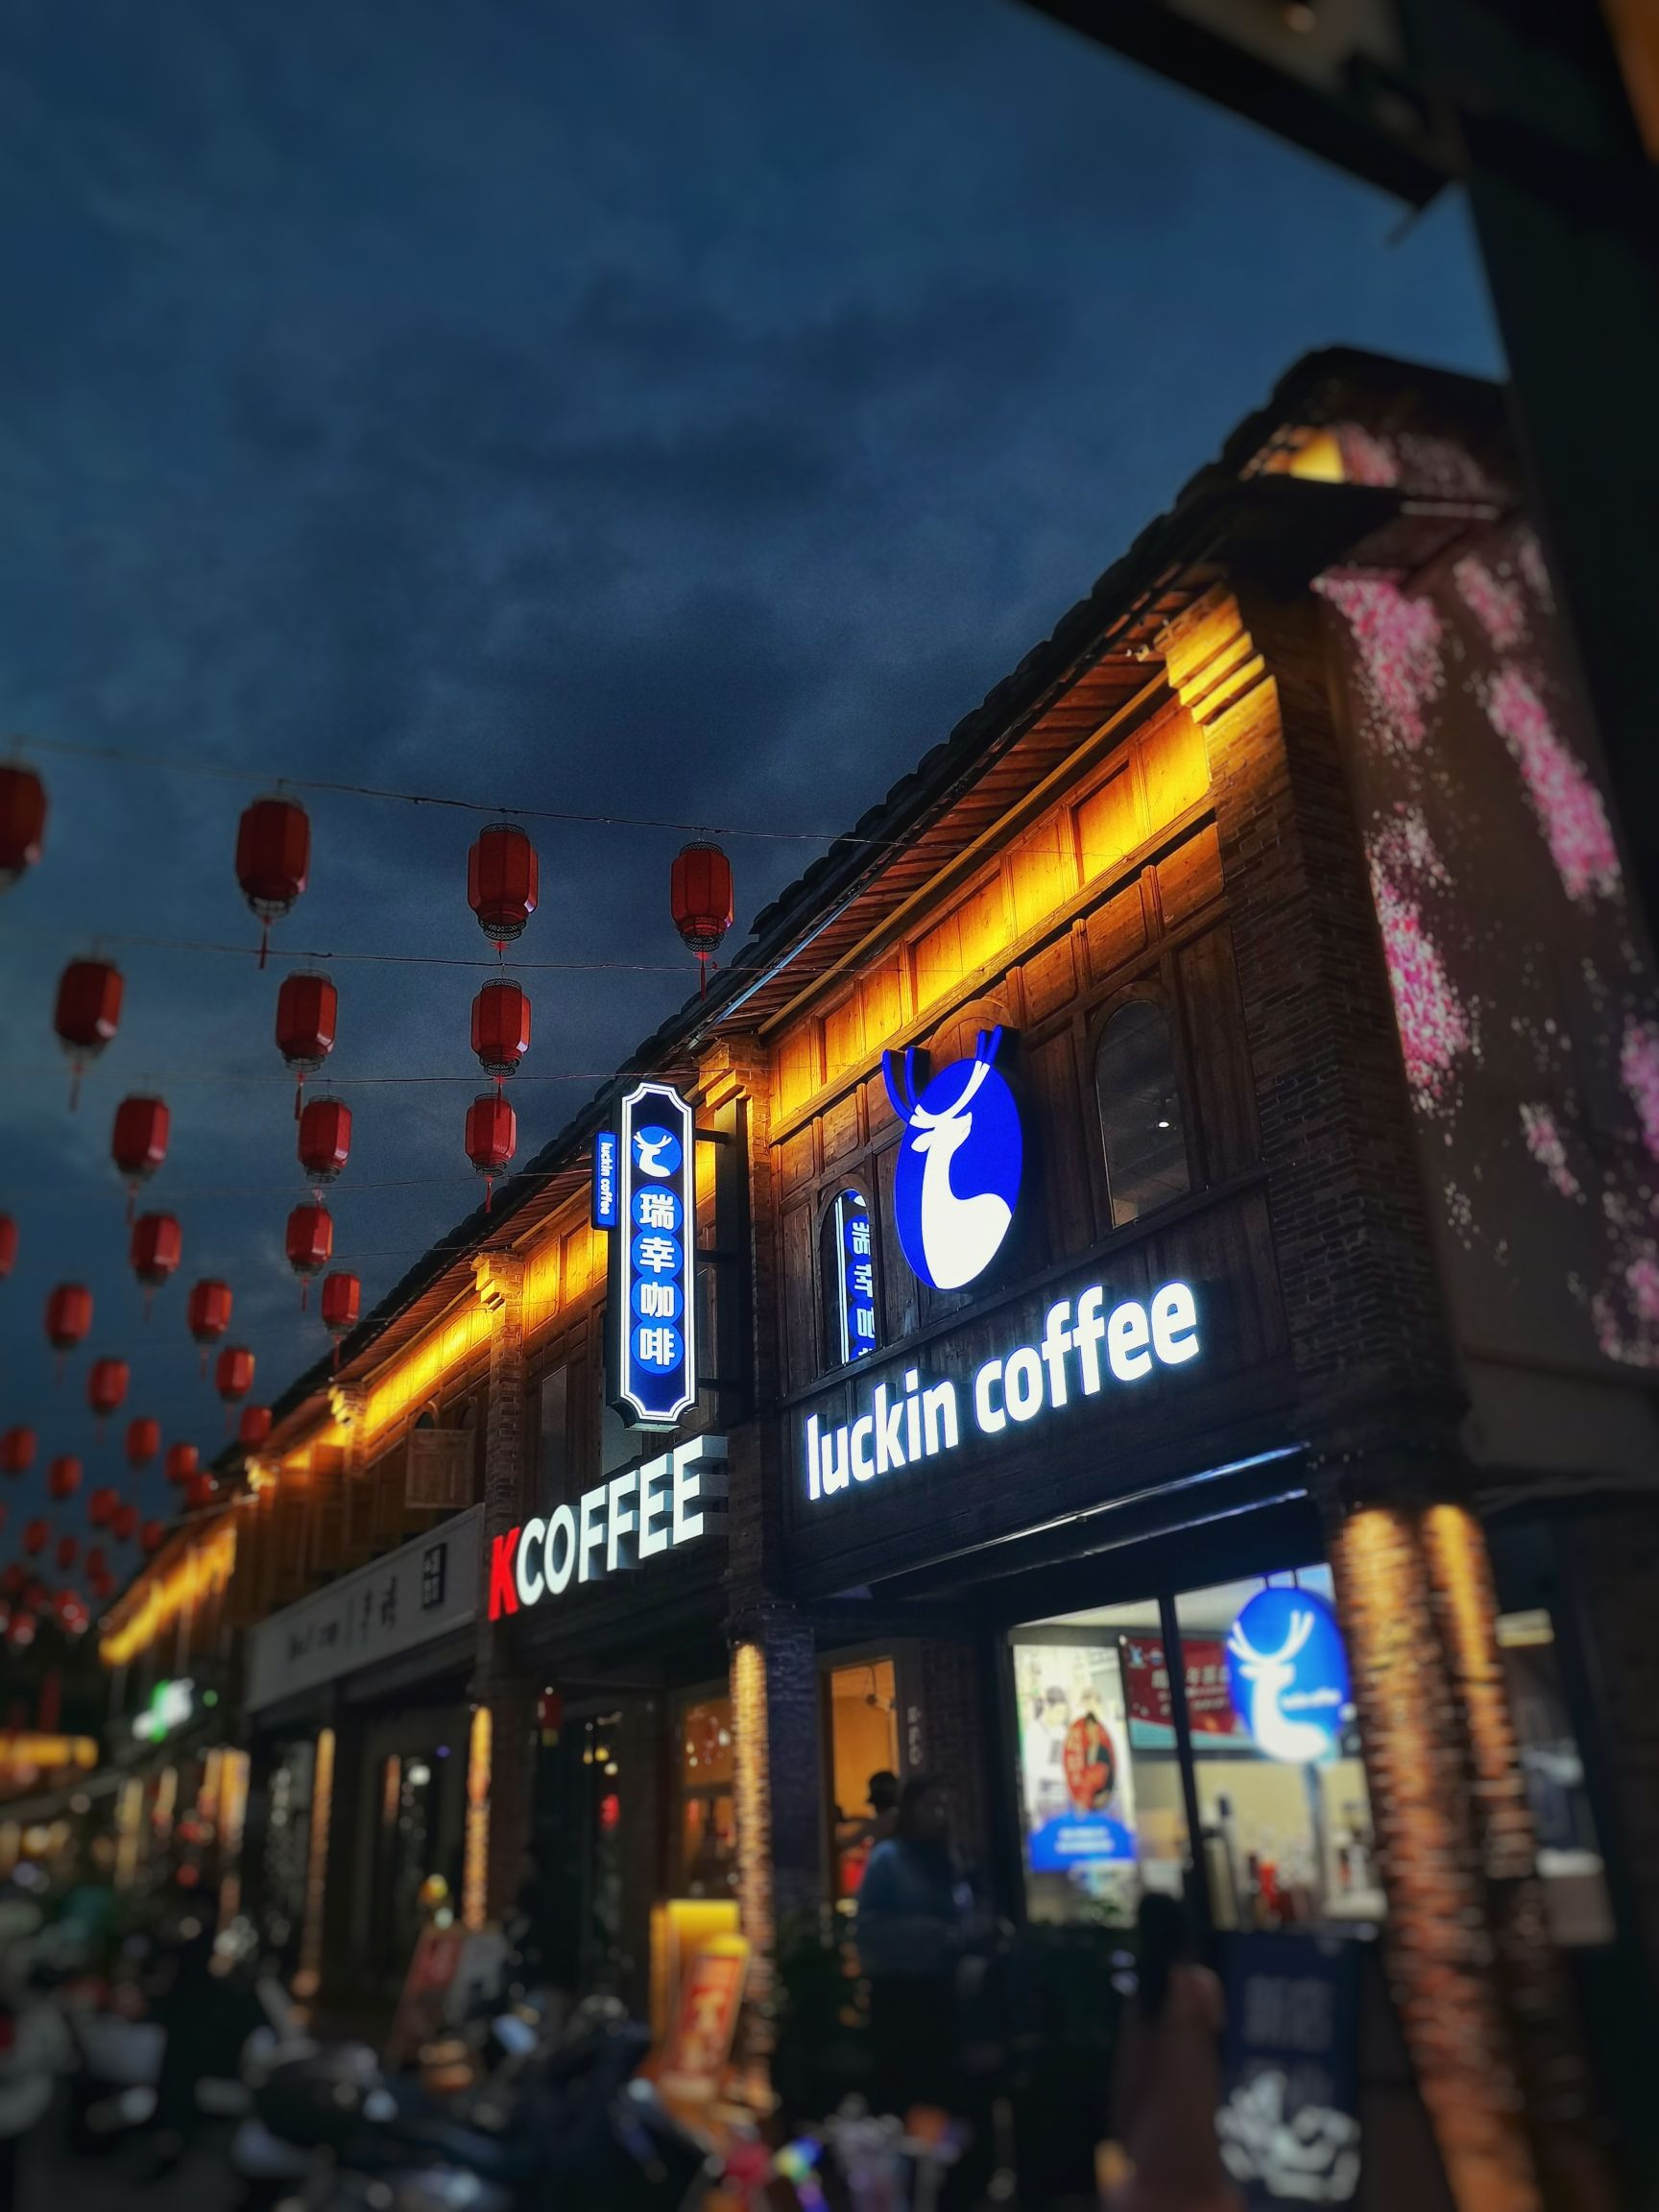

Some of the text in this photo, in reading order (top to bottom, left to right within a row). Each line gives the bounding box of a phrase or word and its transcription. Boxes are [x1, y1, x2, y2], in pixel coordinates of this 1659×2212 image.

[600, 1142, 613, 1215] luckin coffee
[638, 1192, 676, 1365] 瑞幸咖啡
[805, 1280, 1200, 1501] luckin coffee
[487, 1434, 706, 1622] KCOFFEE
